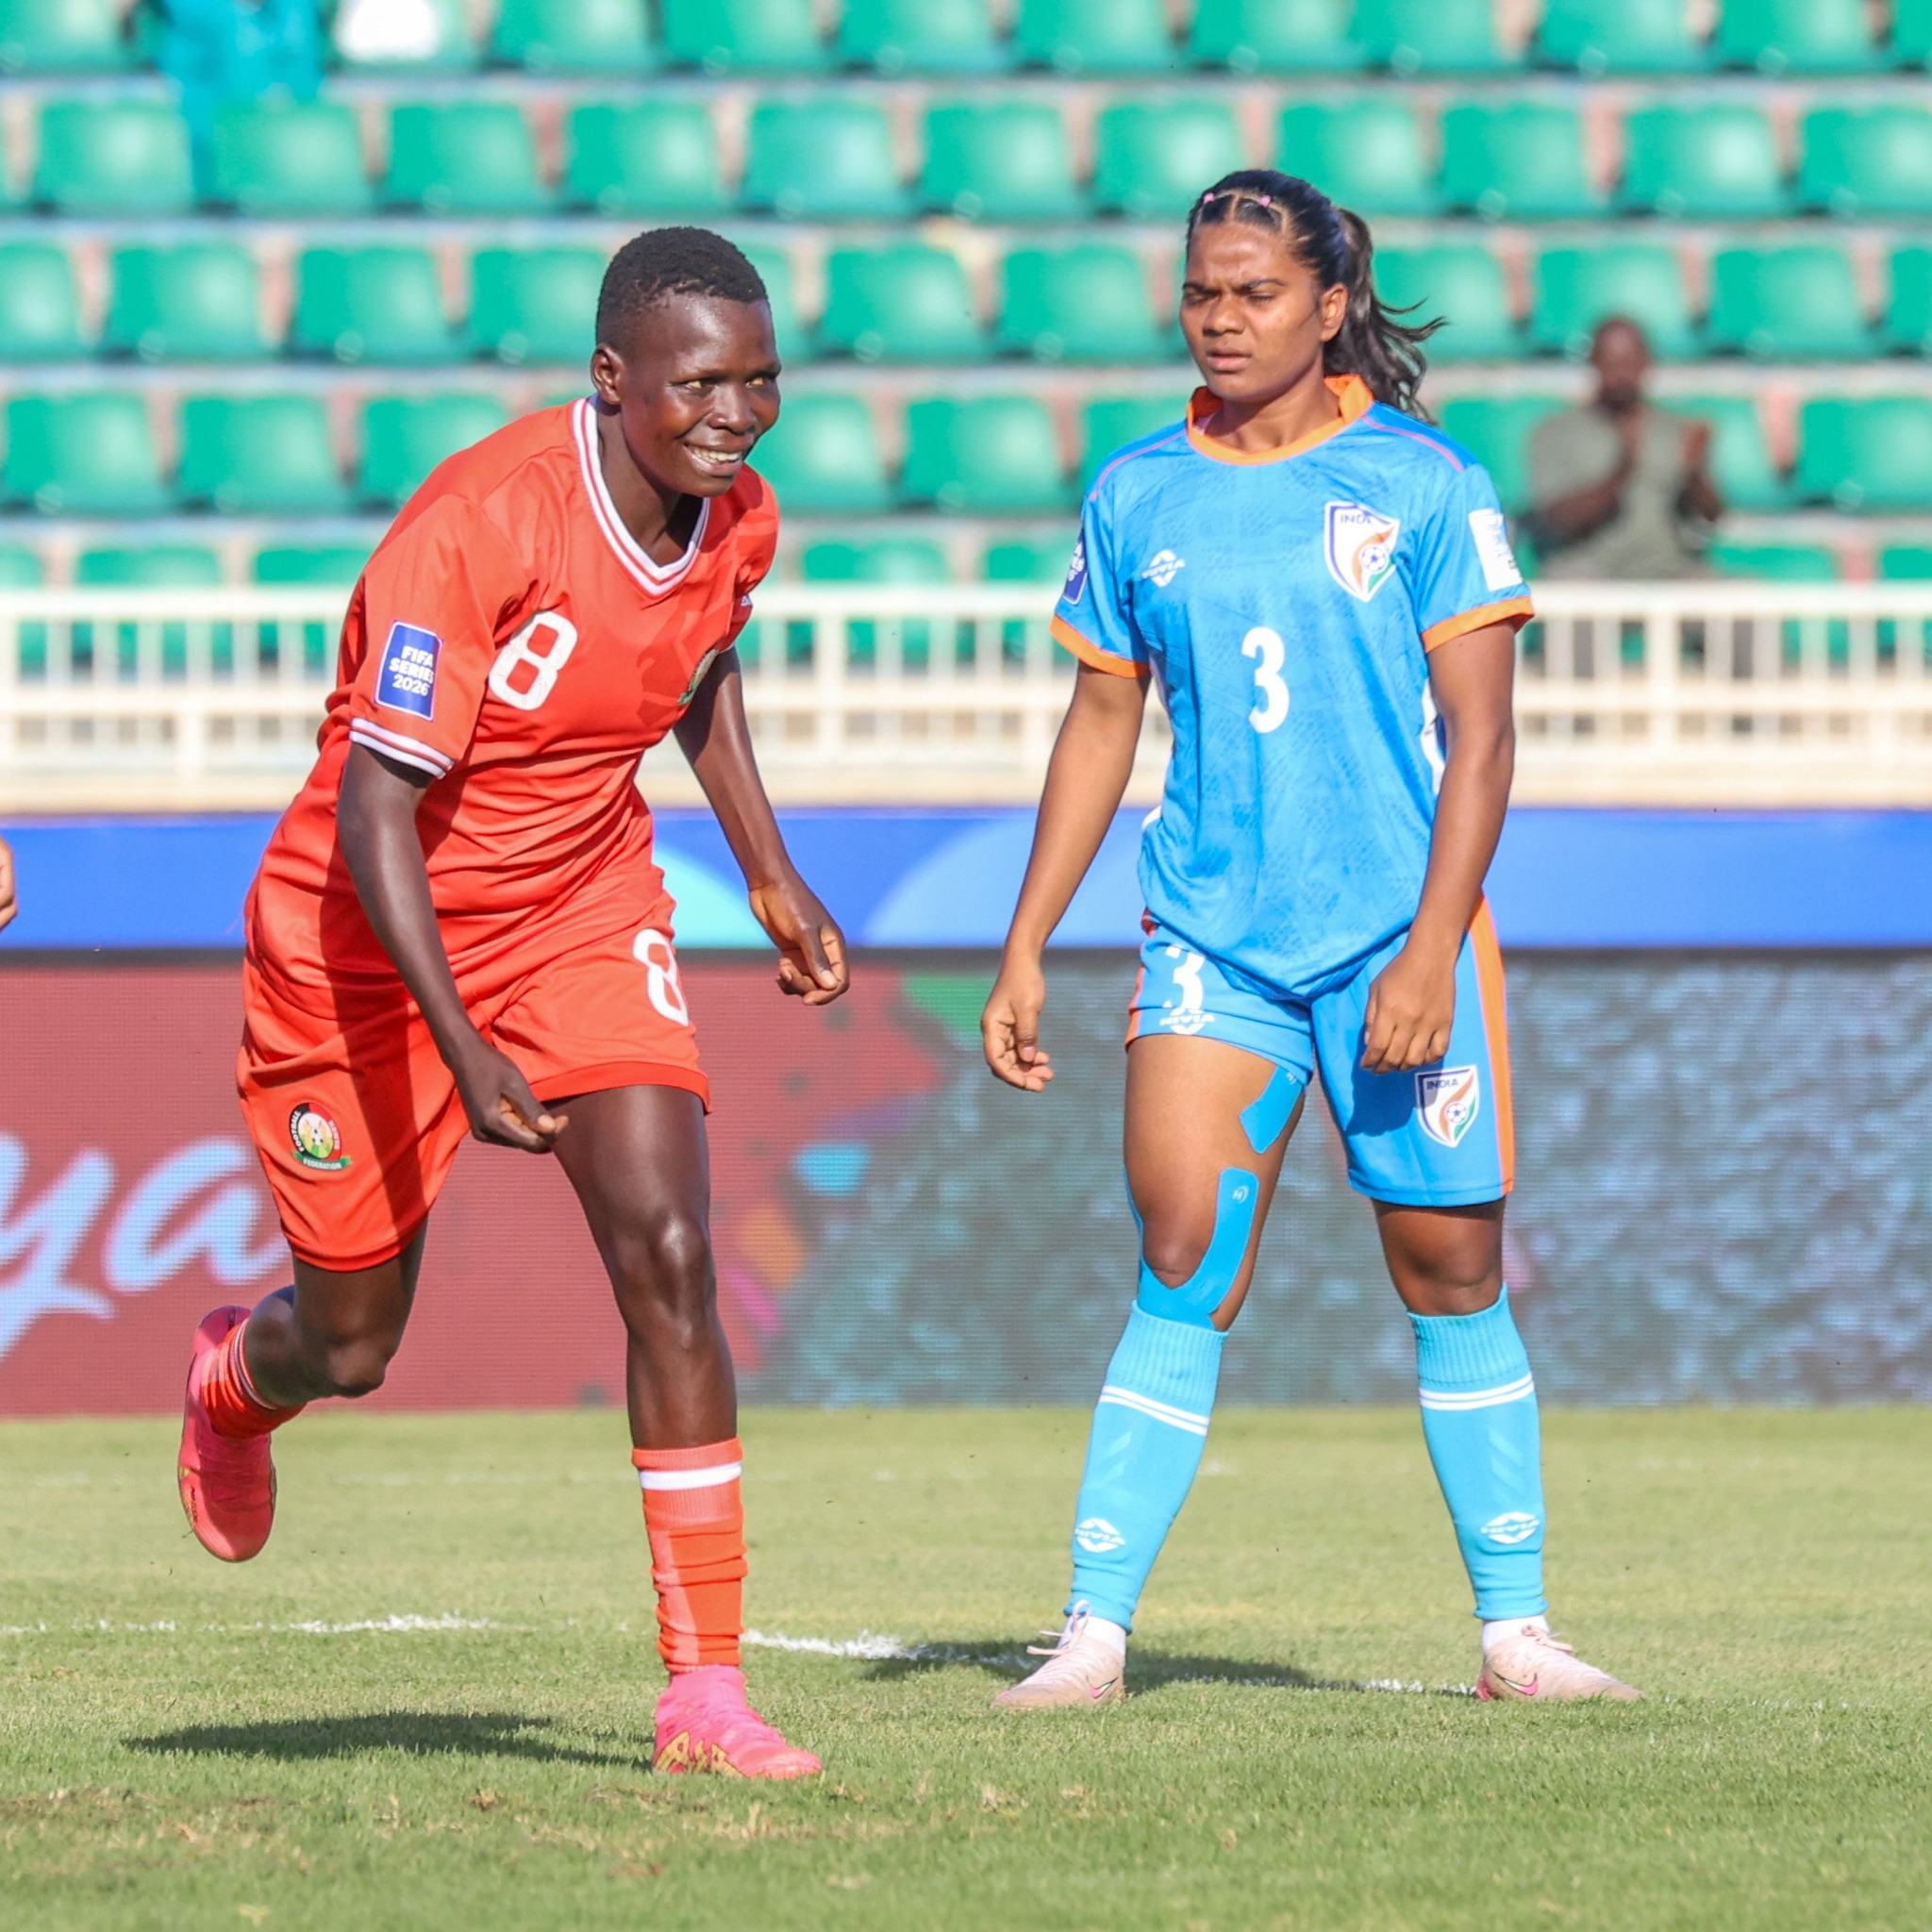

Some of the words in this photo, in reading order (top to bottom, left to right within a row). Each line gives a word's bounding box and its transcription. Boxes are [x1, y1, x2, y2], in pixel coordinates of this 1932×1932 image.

[401, 645, 434, 668] FIFA
[489, 611, 578, 711] 8
[391, 674, 431, 696] 2026
[1241, 626, 1291, 734] 3
[632, 928, 690, 1027] 8
[1161, 945, 1206, 1012] 3
[1158, 1013, 1216, 1027] NIVIA
[1425, 1077, 1459, 1091] INDIA
